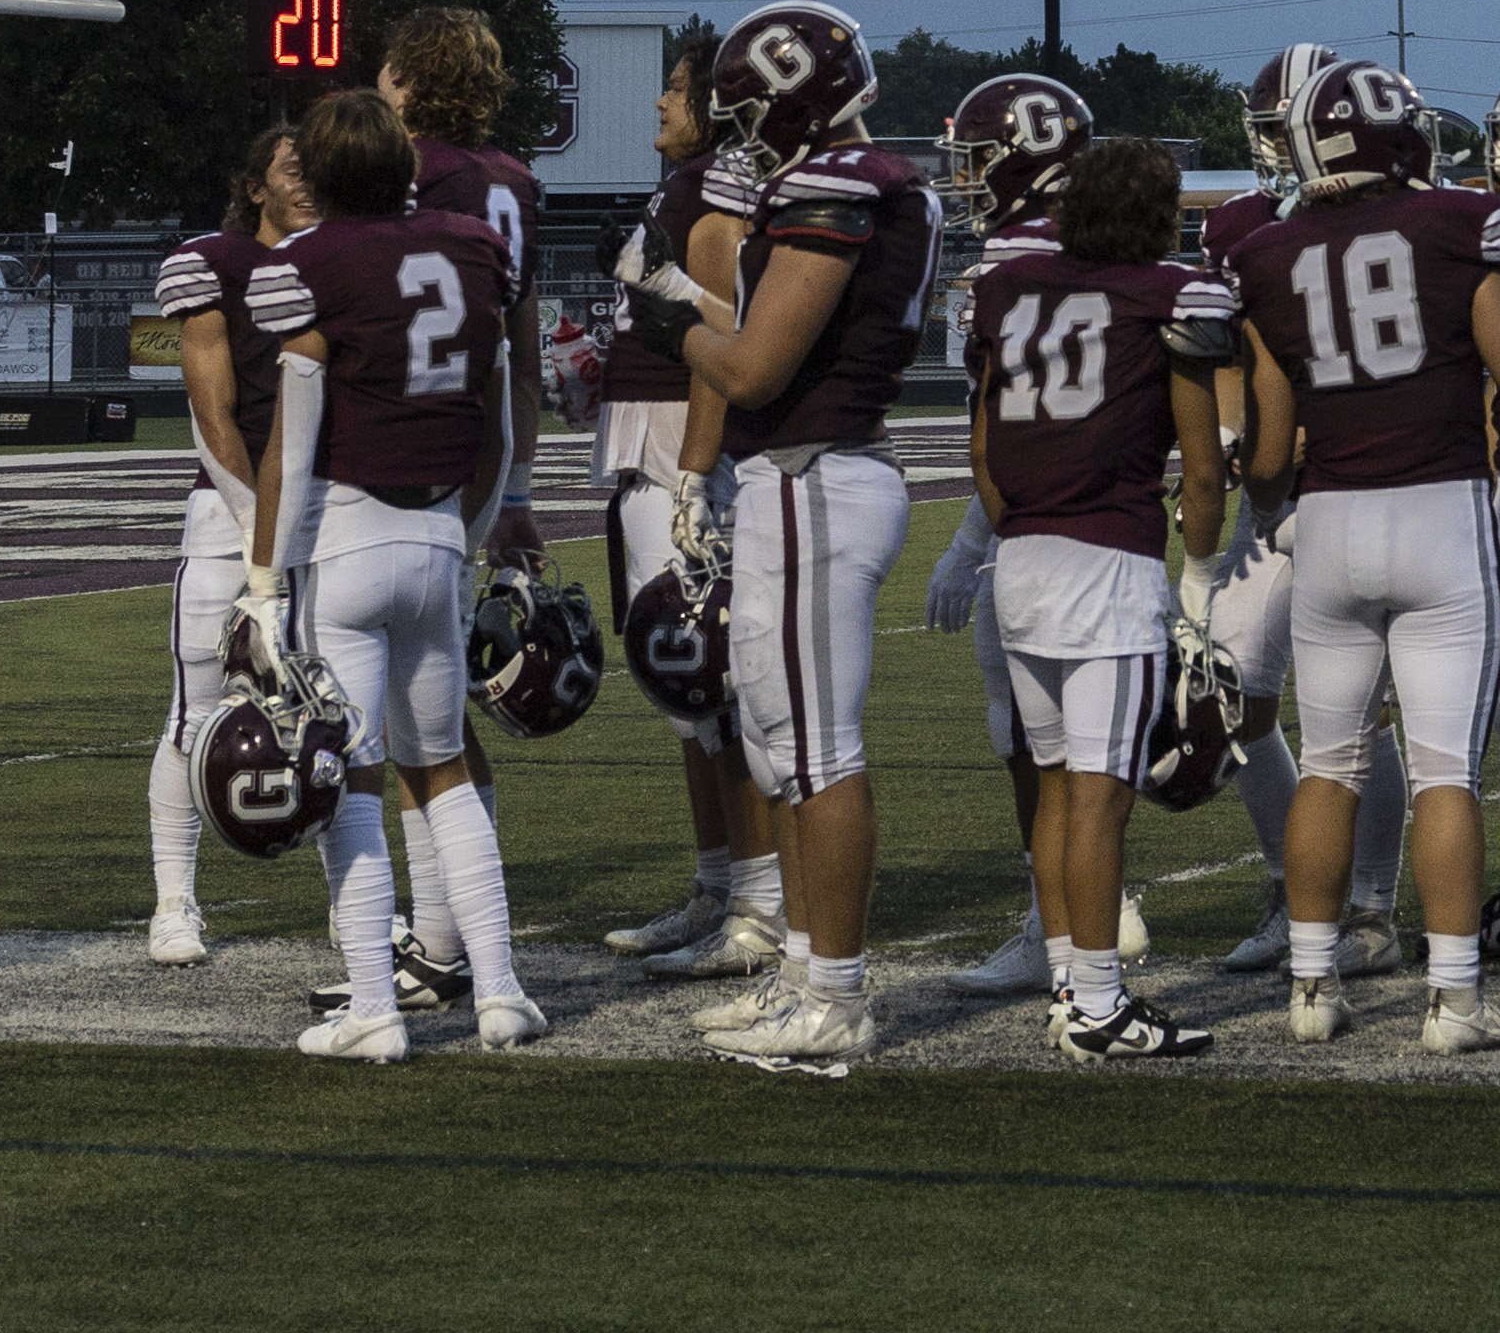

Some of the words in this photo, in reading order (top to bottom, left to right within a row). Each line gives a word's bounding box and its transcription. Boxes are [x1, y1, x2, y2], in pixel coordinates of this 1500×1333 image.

[746, 23, 816, 94] G
[1008, 91, 1068, 157] G
[1348, 67, 1408, 125] G
[396, 250, 470, 398] 2
[1290, 229, 1429, 390] 18
[998, 290, 1113, 422] 10
[647, 623, 708, 676] G
[227, 768, 302, 826] G
